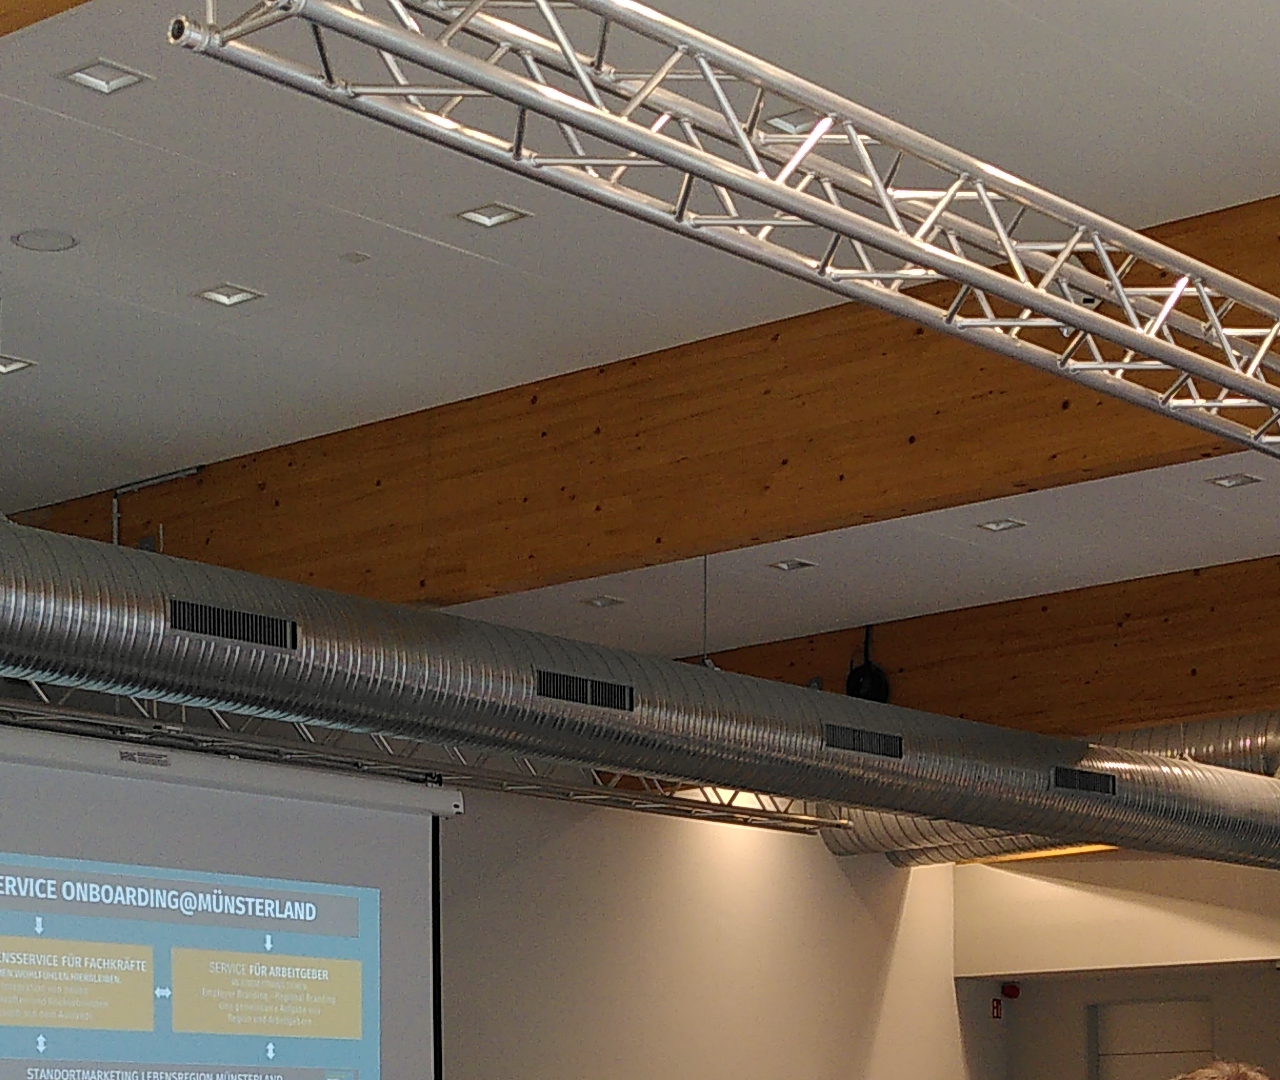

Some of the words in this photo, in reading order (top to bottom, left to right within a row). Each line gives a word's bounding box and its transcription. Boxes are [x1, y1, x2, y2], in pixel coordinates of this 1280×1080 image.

[61, 881, 317, 922] ONBOARDING@MÜNSTERLAND
[62, 953, 82, 968] FÜR
[84, 956, 147, 972] FACHKRÄFTE
[209, 961, 246, 975] SERVICE
[249, 962, 267, 976] FÜR
[269, 966, 329, 981] ARBEITGEBER
